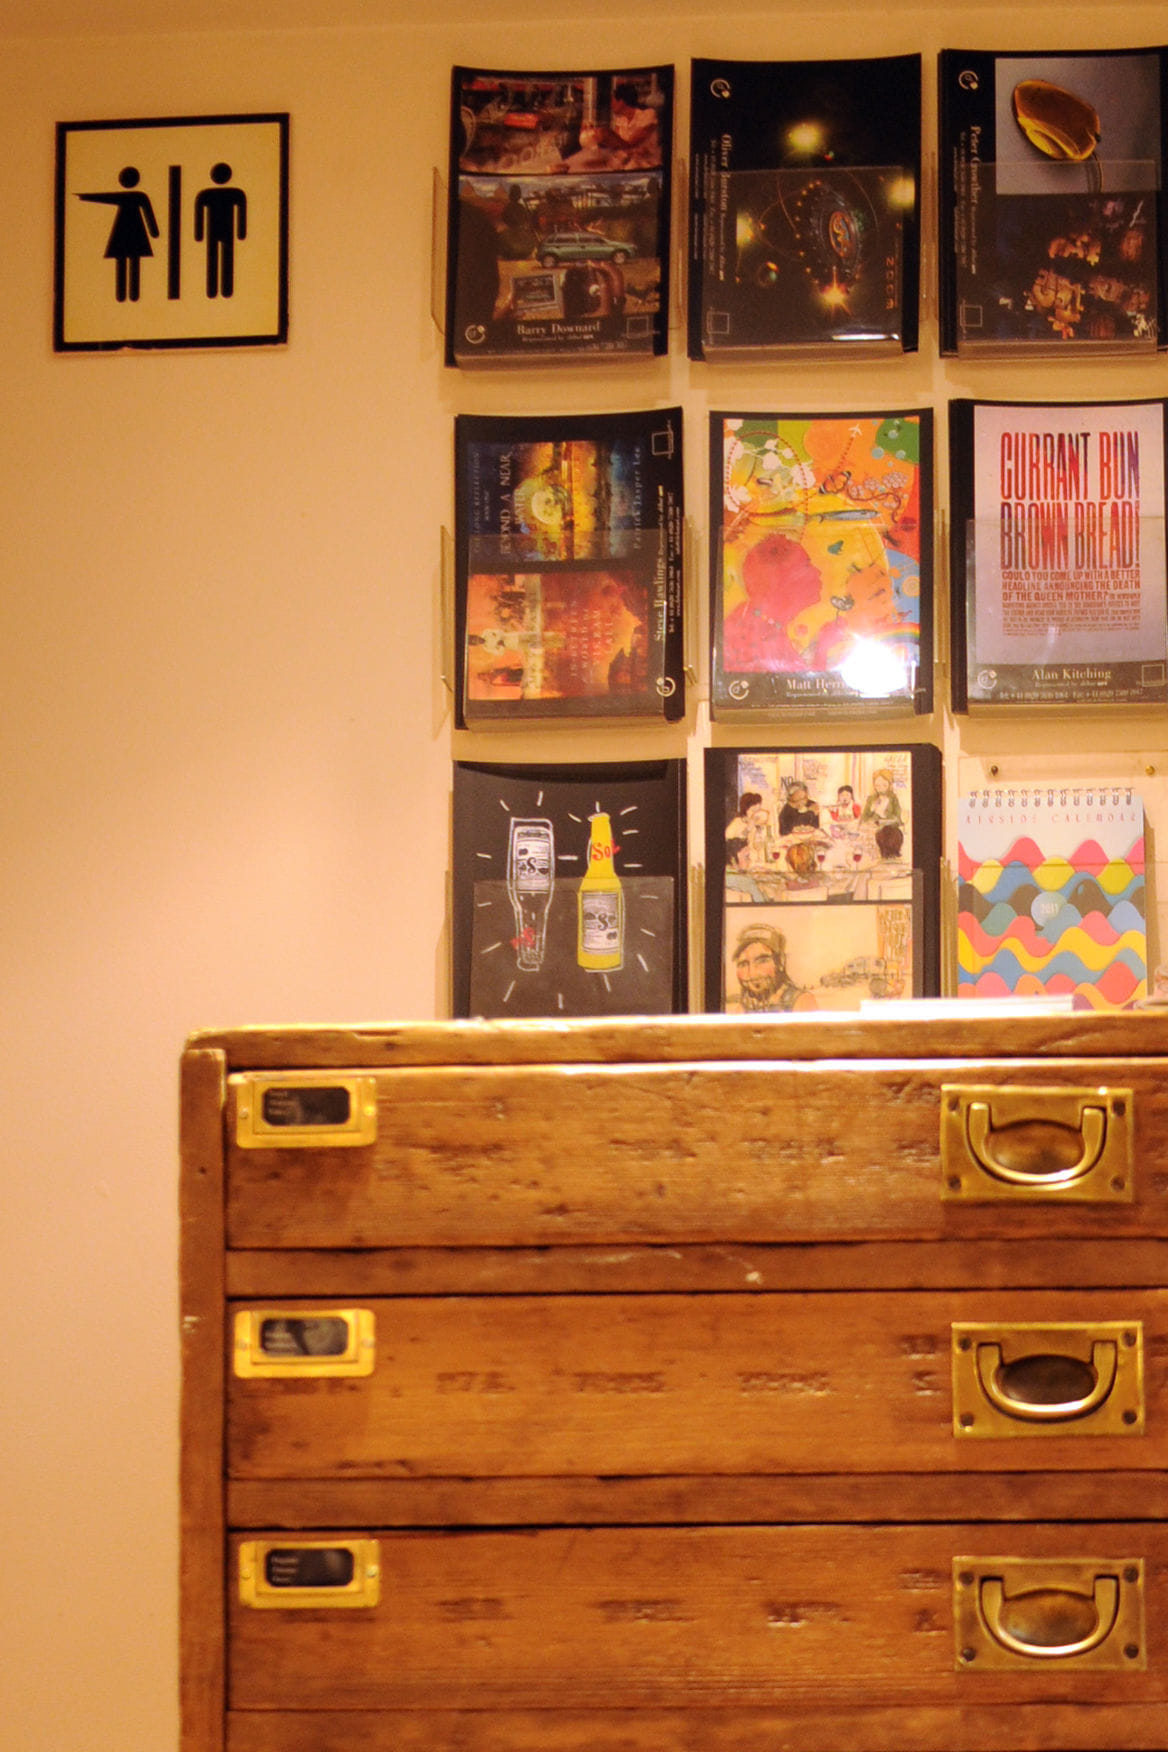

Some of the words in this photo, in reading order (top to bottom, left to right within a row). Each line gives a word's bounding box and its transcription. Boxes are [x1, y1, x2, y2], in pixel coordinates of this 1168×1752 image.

[721, 134, 732, 167] Oliver
[970, 126, 982, 154] Peter
[970, 157, 981, 204] Crowther
[517, 325, 546, 335] Barry
[552, 322, 600, 333] Downard
[500, 452, 512, 485] NEAR
[633, 447, 641, 465] Lee
[1000, 432, 1091, 501] CURRANT
[1099, 431, 1140, 500] BUN
[633, 471, 642, 505] Jasper
[500, 510, 511, 554] BEYOND
[632, 510, 641, 549] Patrick
[1000, 502, 1069, 570] BROWN
[1075, 500, 1140, 569] BREAD!
[653, 558, 664, 607] Rawlings
[1002, 571, 1030, 581] COULD
[1032, 571, 1048, 581] YOU
[1050, 571, 1072, 581] COME
[1074, 570, 1083, 581] UP
[1085, 570, 1102, 580] WITH
[1104, 570, 1109, 580] A
[1110, 570, 1140, 580] BETTER
[1002, 581, 1041, 591] HEADLINE
[1044, 581, 1094, 591] ANNOUNCING
[1096, 581, 1110, 590] THE
[1113, 580, 1140, 590] DEATH
[1002, 592, 1013, 602] OF
[1016, 592, 1033, 601] THE
[1034, 592, 1063, 601] QUEEN
[1065, 591, 1108, 601] MOTHER?
[654, 611, 664, 641] Steve
[787, 679, 811, 689] Matt
[1032, 669, 1058, 680] Alan
[1063, 668, 1112, 680] Kitching
